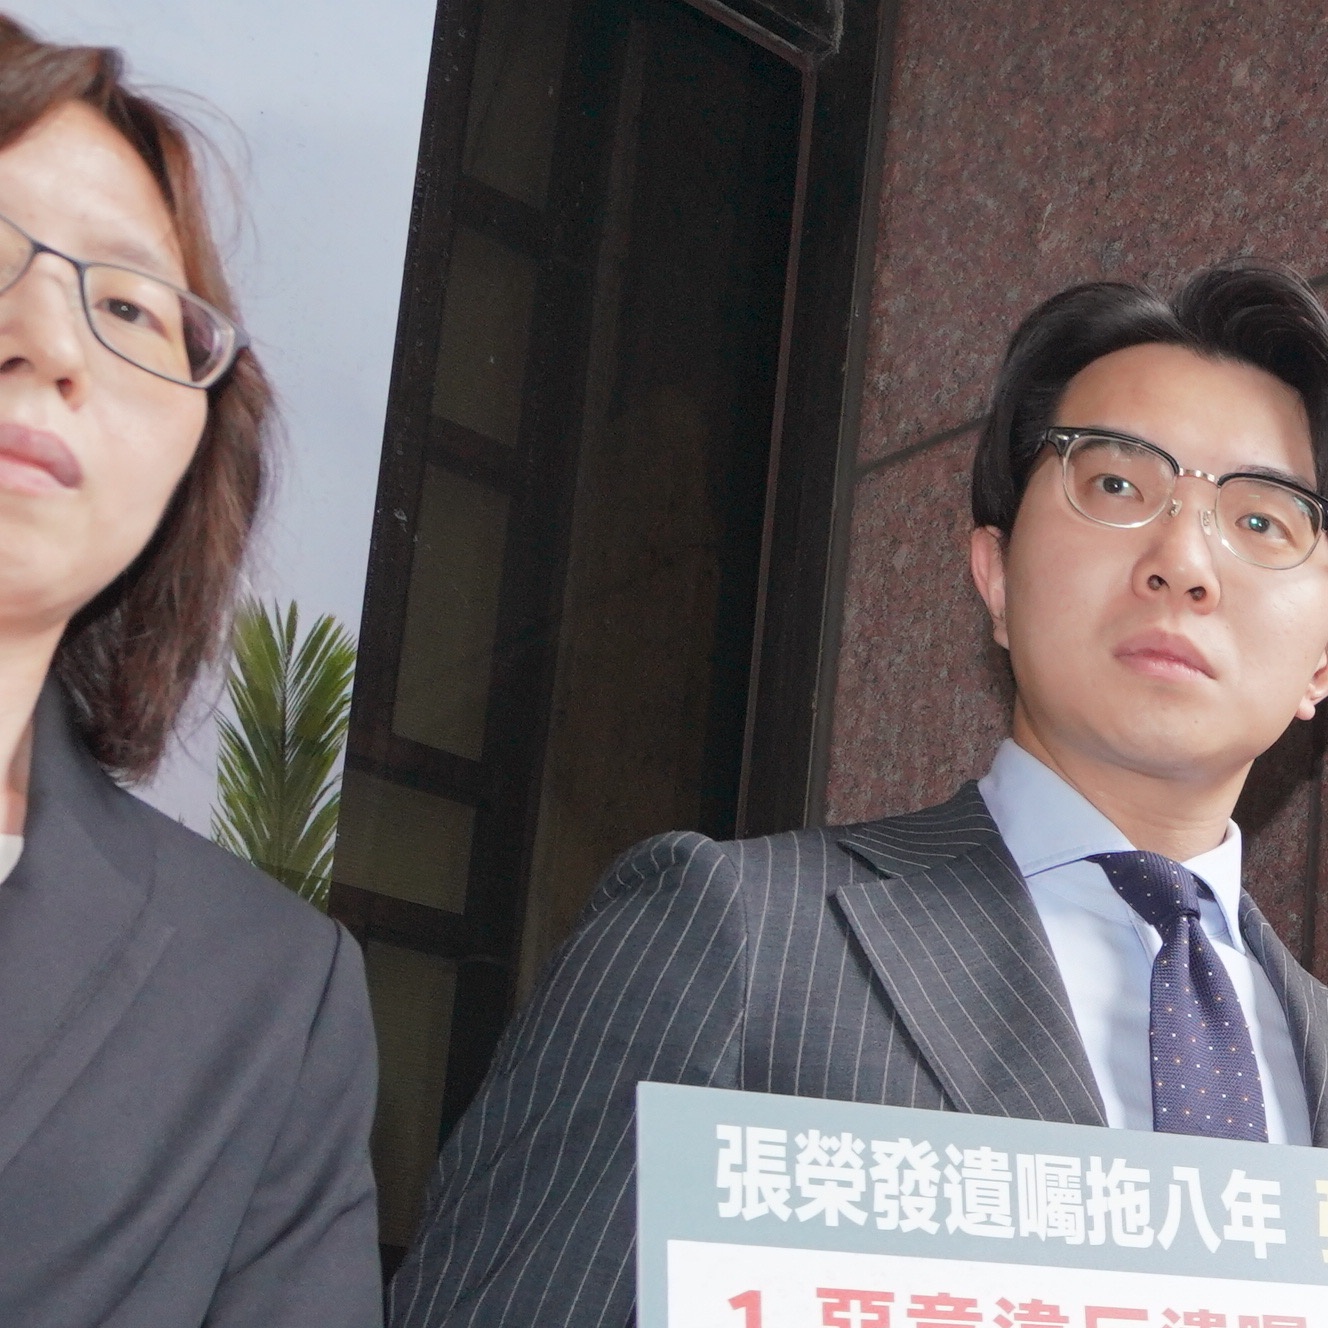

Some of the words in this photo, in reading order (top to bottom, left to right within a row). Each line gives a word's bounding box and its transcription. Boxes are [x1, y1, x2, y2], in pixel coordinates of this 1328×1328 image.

[716, 1124, 1287, 1260] 張榮發遺囑拖八年
